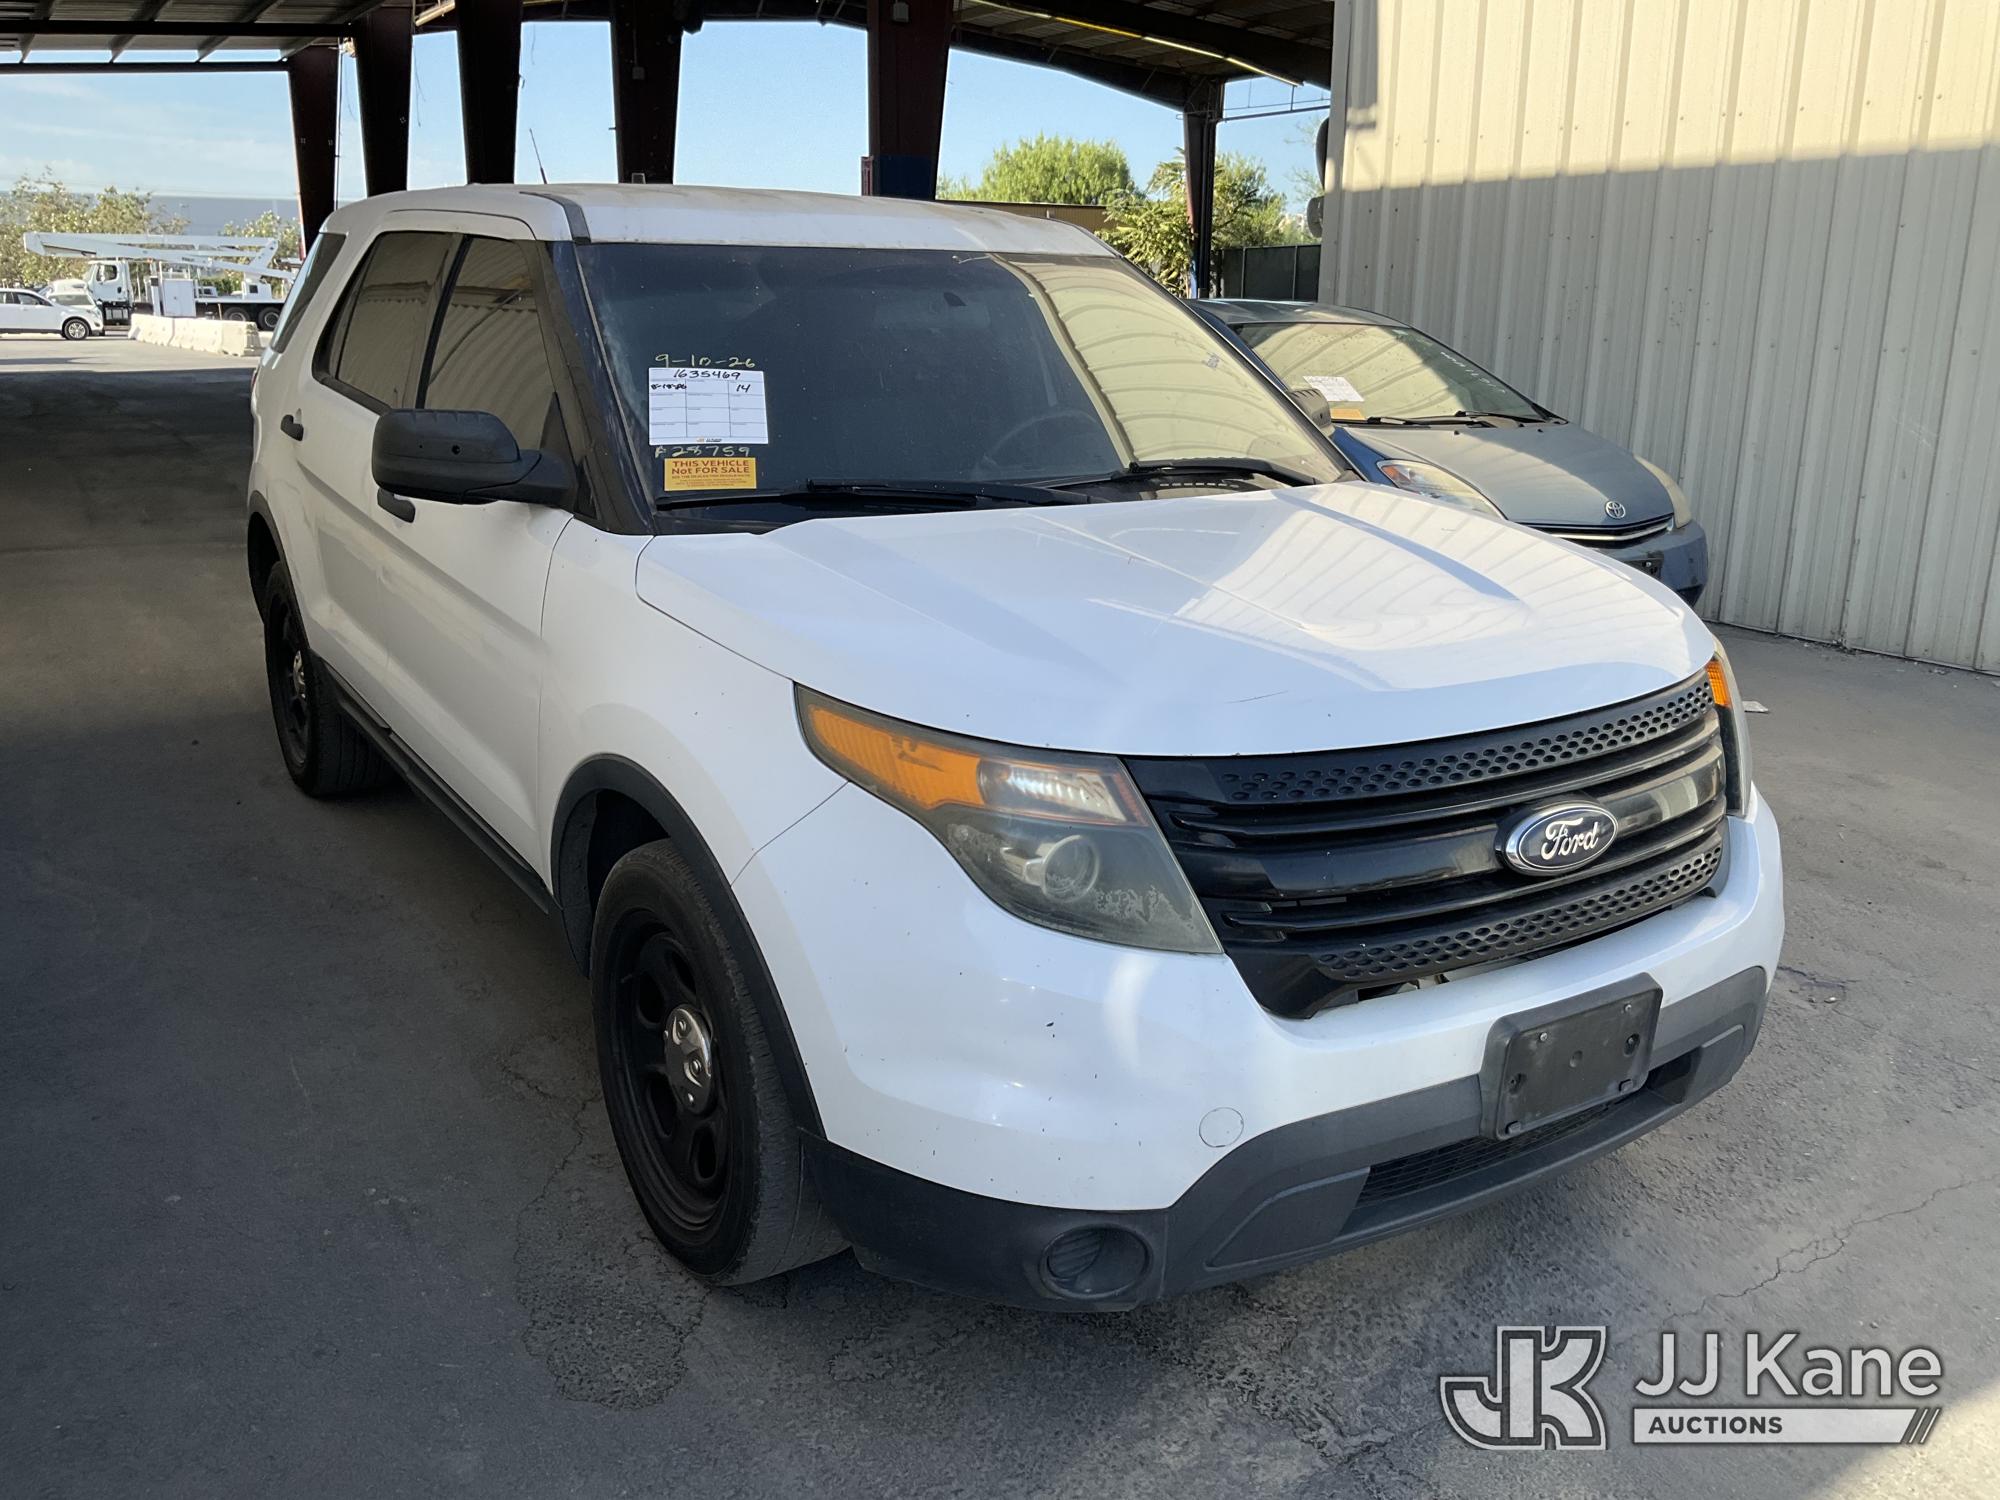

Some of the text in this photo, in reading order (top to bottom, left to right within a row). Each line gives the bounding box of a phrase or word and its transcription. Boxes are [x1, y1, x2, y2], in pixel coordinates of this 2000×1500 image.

[673, 369, 741, 379] 1635469
[735, 384, 752, 393] 14
[701, 459, 749, 467] VEHICLE
[720, 466, 750, 474] SALE
[1541, 817, 1599, 860] Ford
